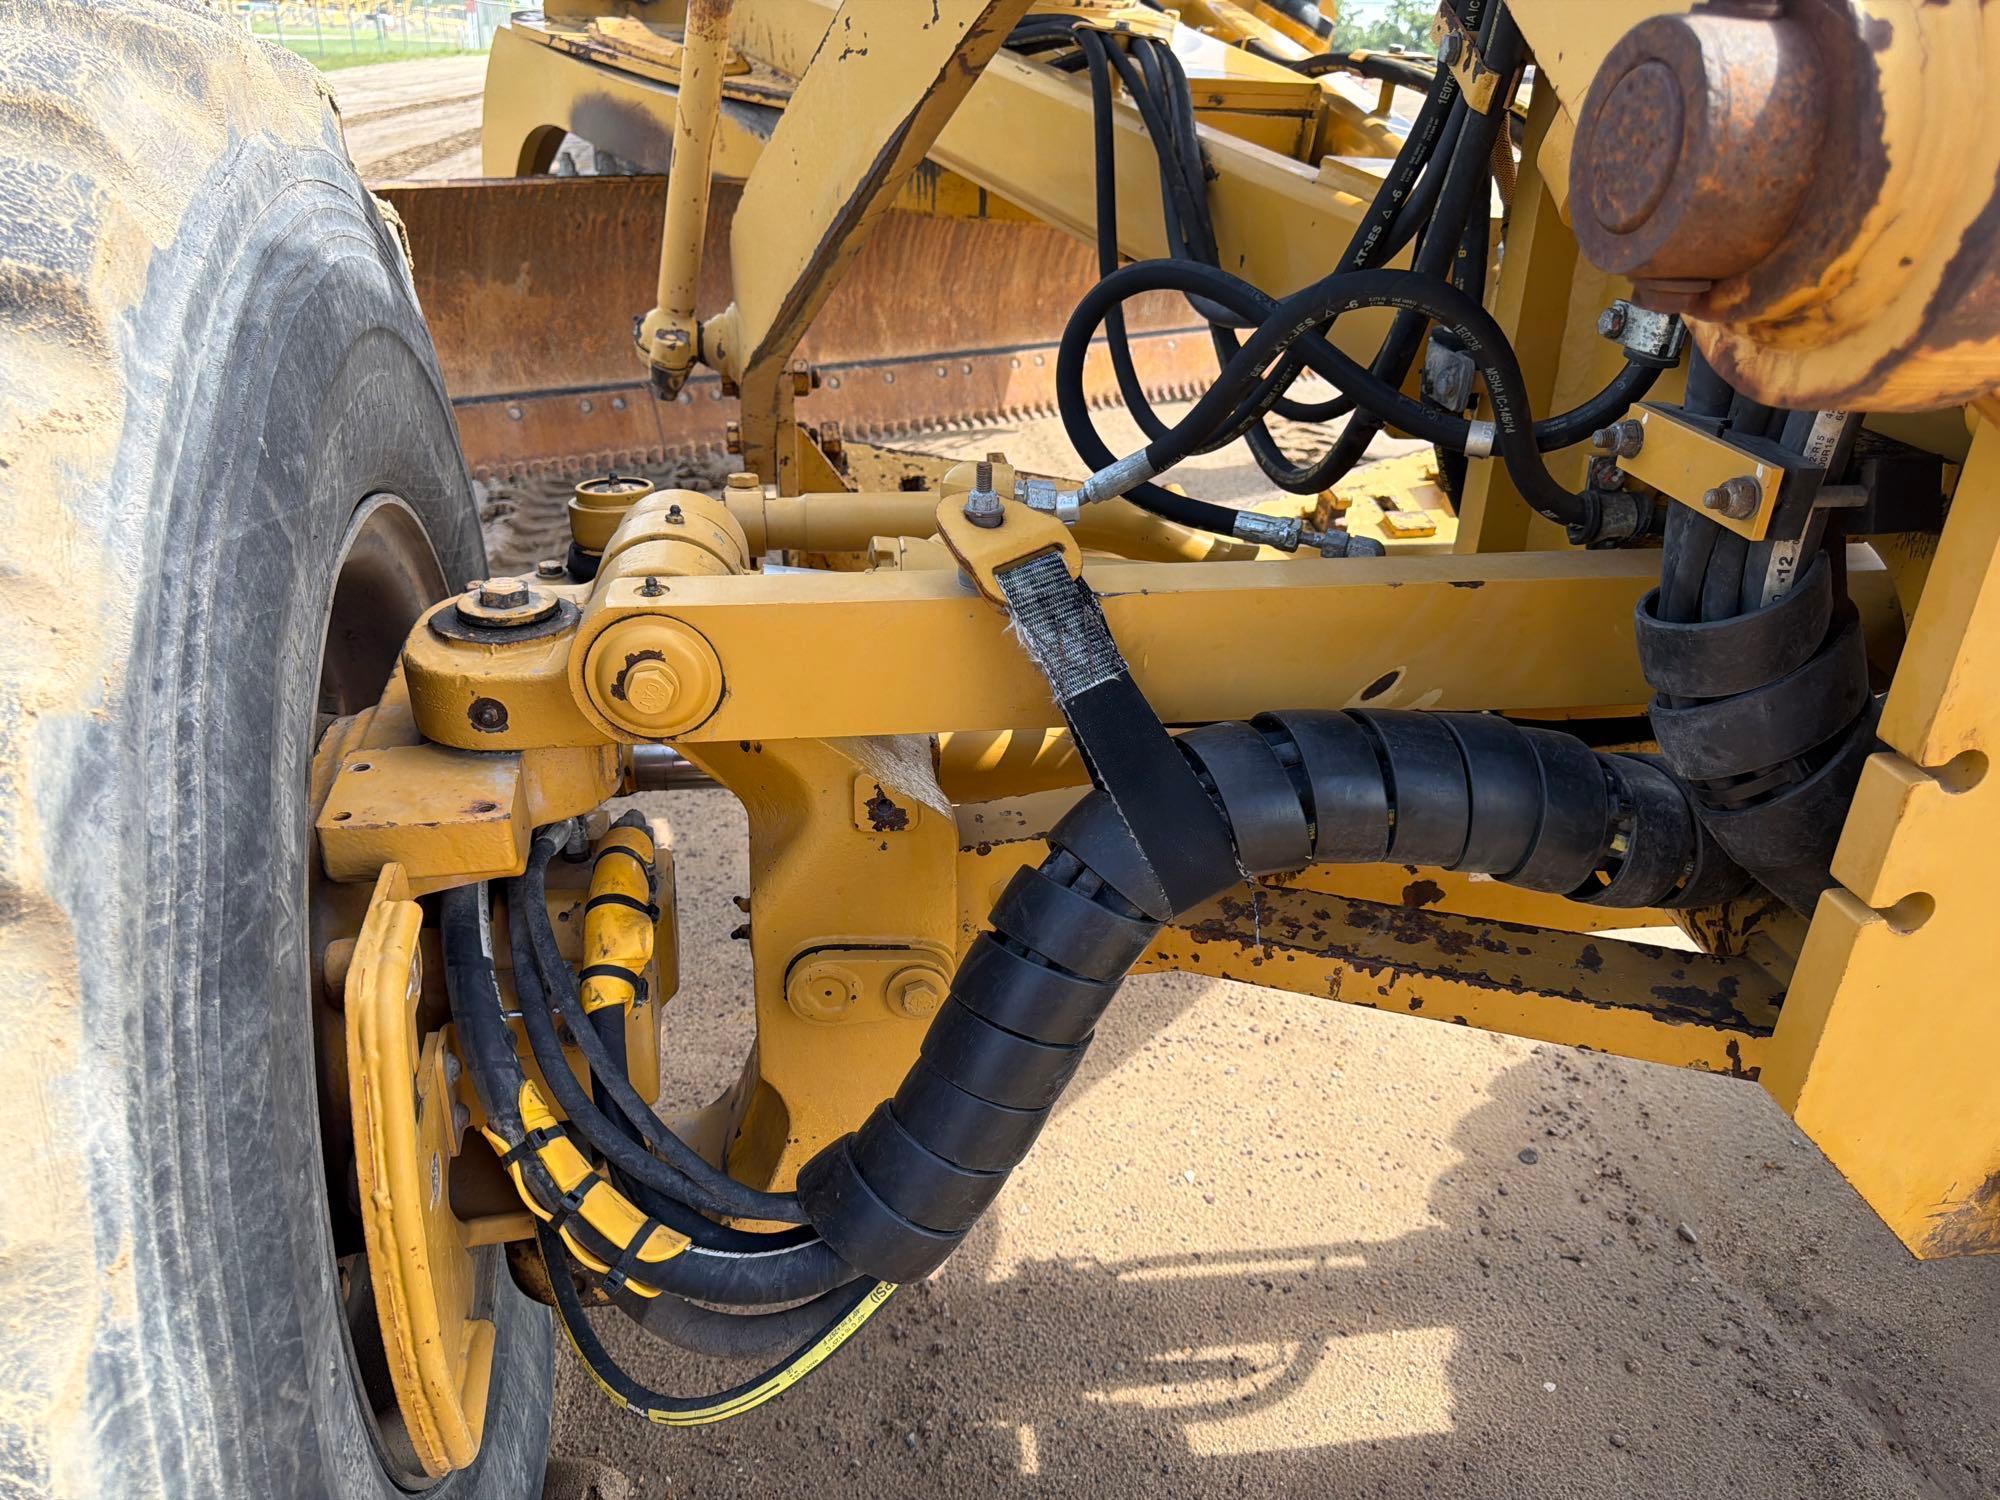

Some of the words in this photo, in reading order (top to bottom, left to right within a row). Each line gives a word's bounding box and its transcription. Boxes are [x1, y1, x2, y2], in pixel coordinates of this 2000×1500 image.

[1353, 225, 1382, 267] XT-3ES
[1392, 189, 1403, 203] -6
[1276, 317, 1316, 352] XT-3ES
[1344, 299, 1359, 310] -6
[1453, 324, 1483, 352] 1E0736
[1485, 367, 1504, 400] MSHA
[1808, 434, 1826, 464] 2-R15
